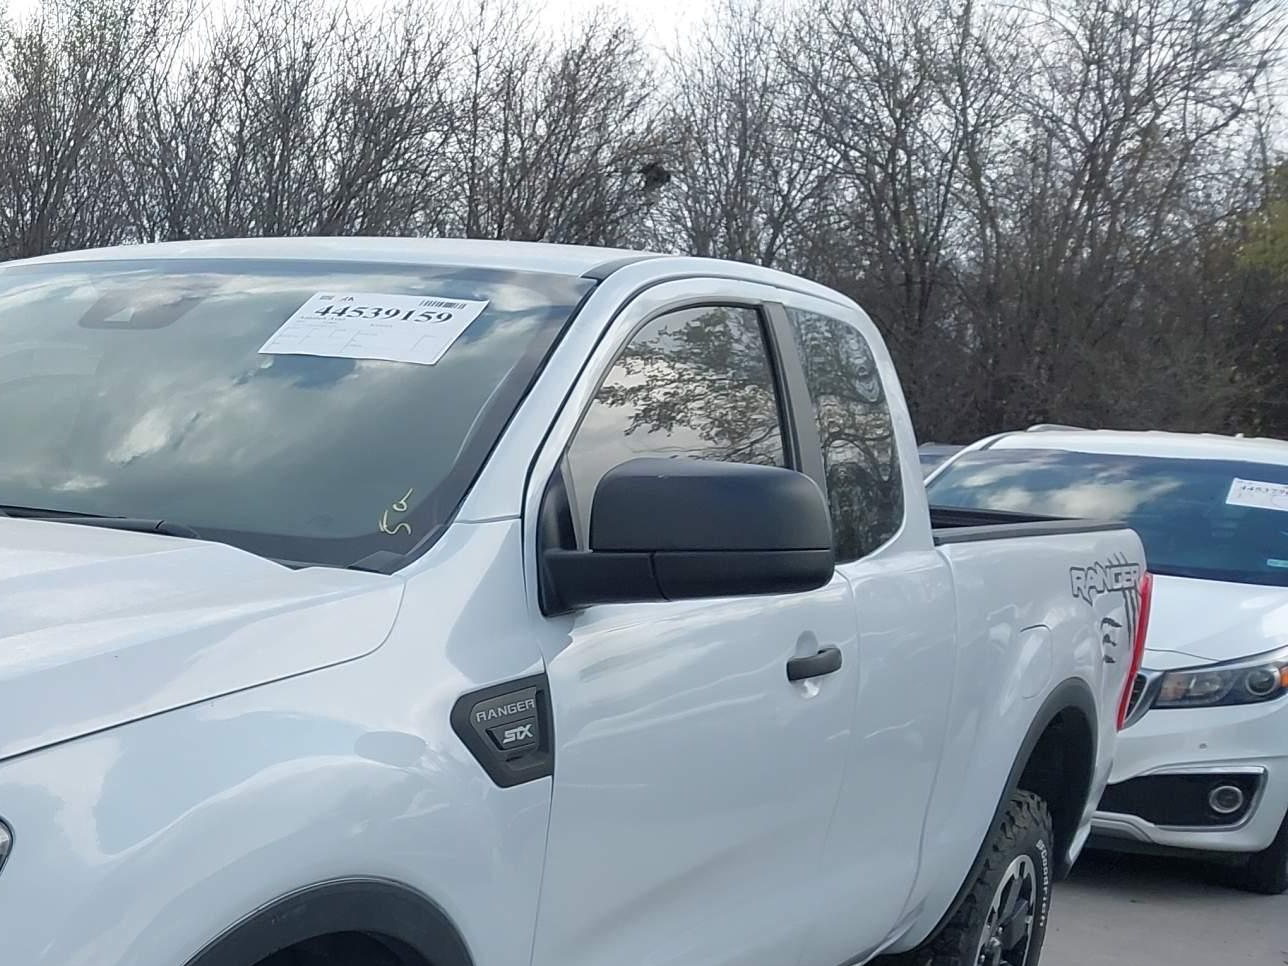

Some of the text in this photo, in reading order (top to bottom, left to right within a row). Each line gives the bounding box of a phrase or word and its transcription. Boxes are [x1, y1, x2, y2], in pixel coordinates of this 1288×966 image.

[314, 304, 454, 325] 44539159
[1069, 560, 1140, 607] RANGER
[475, 698, 536, 723] RANGER
[502, 723, 534, 745] STX
